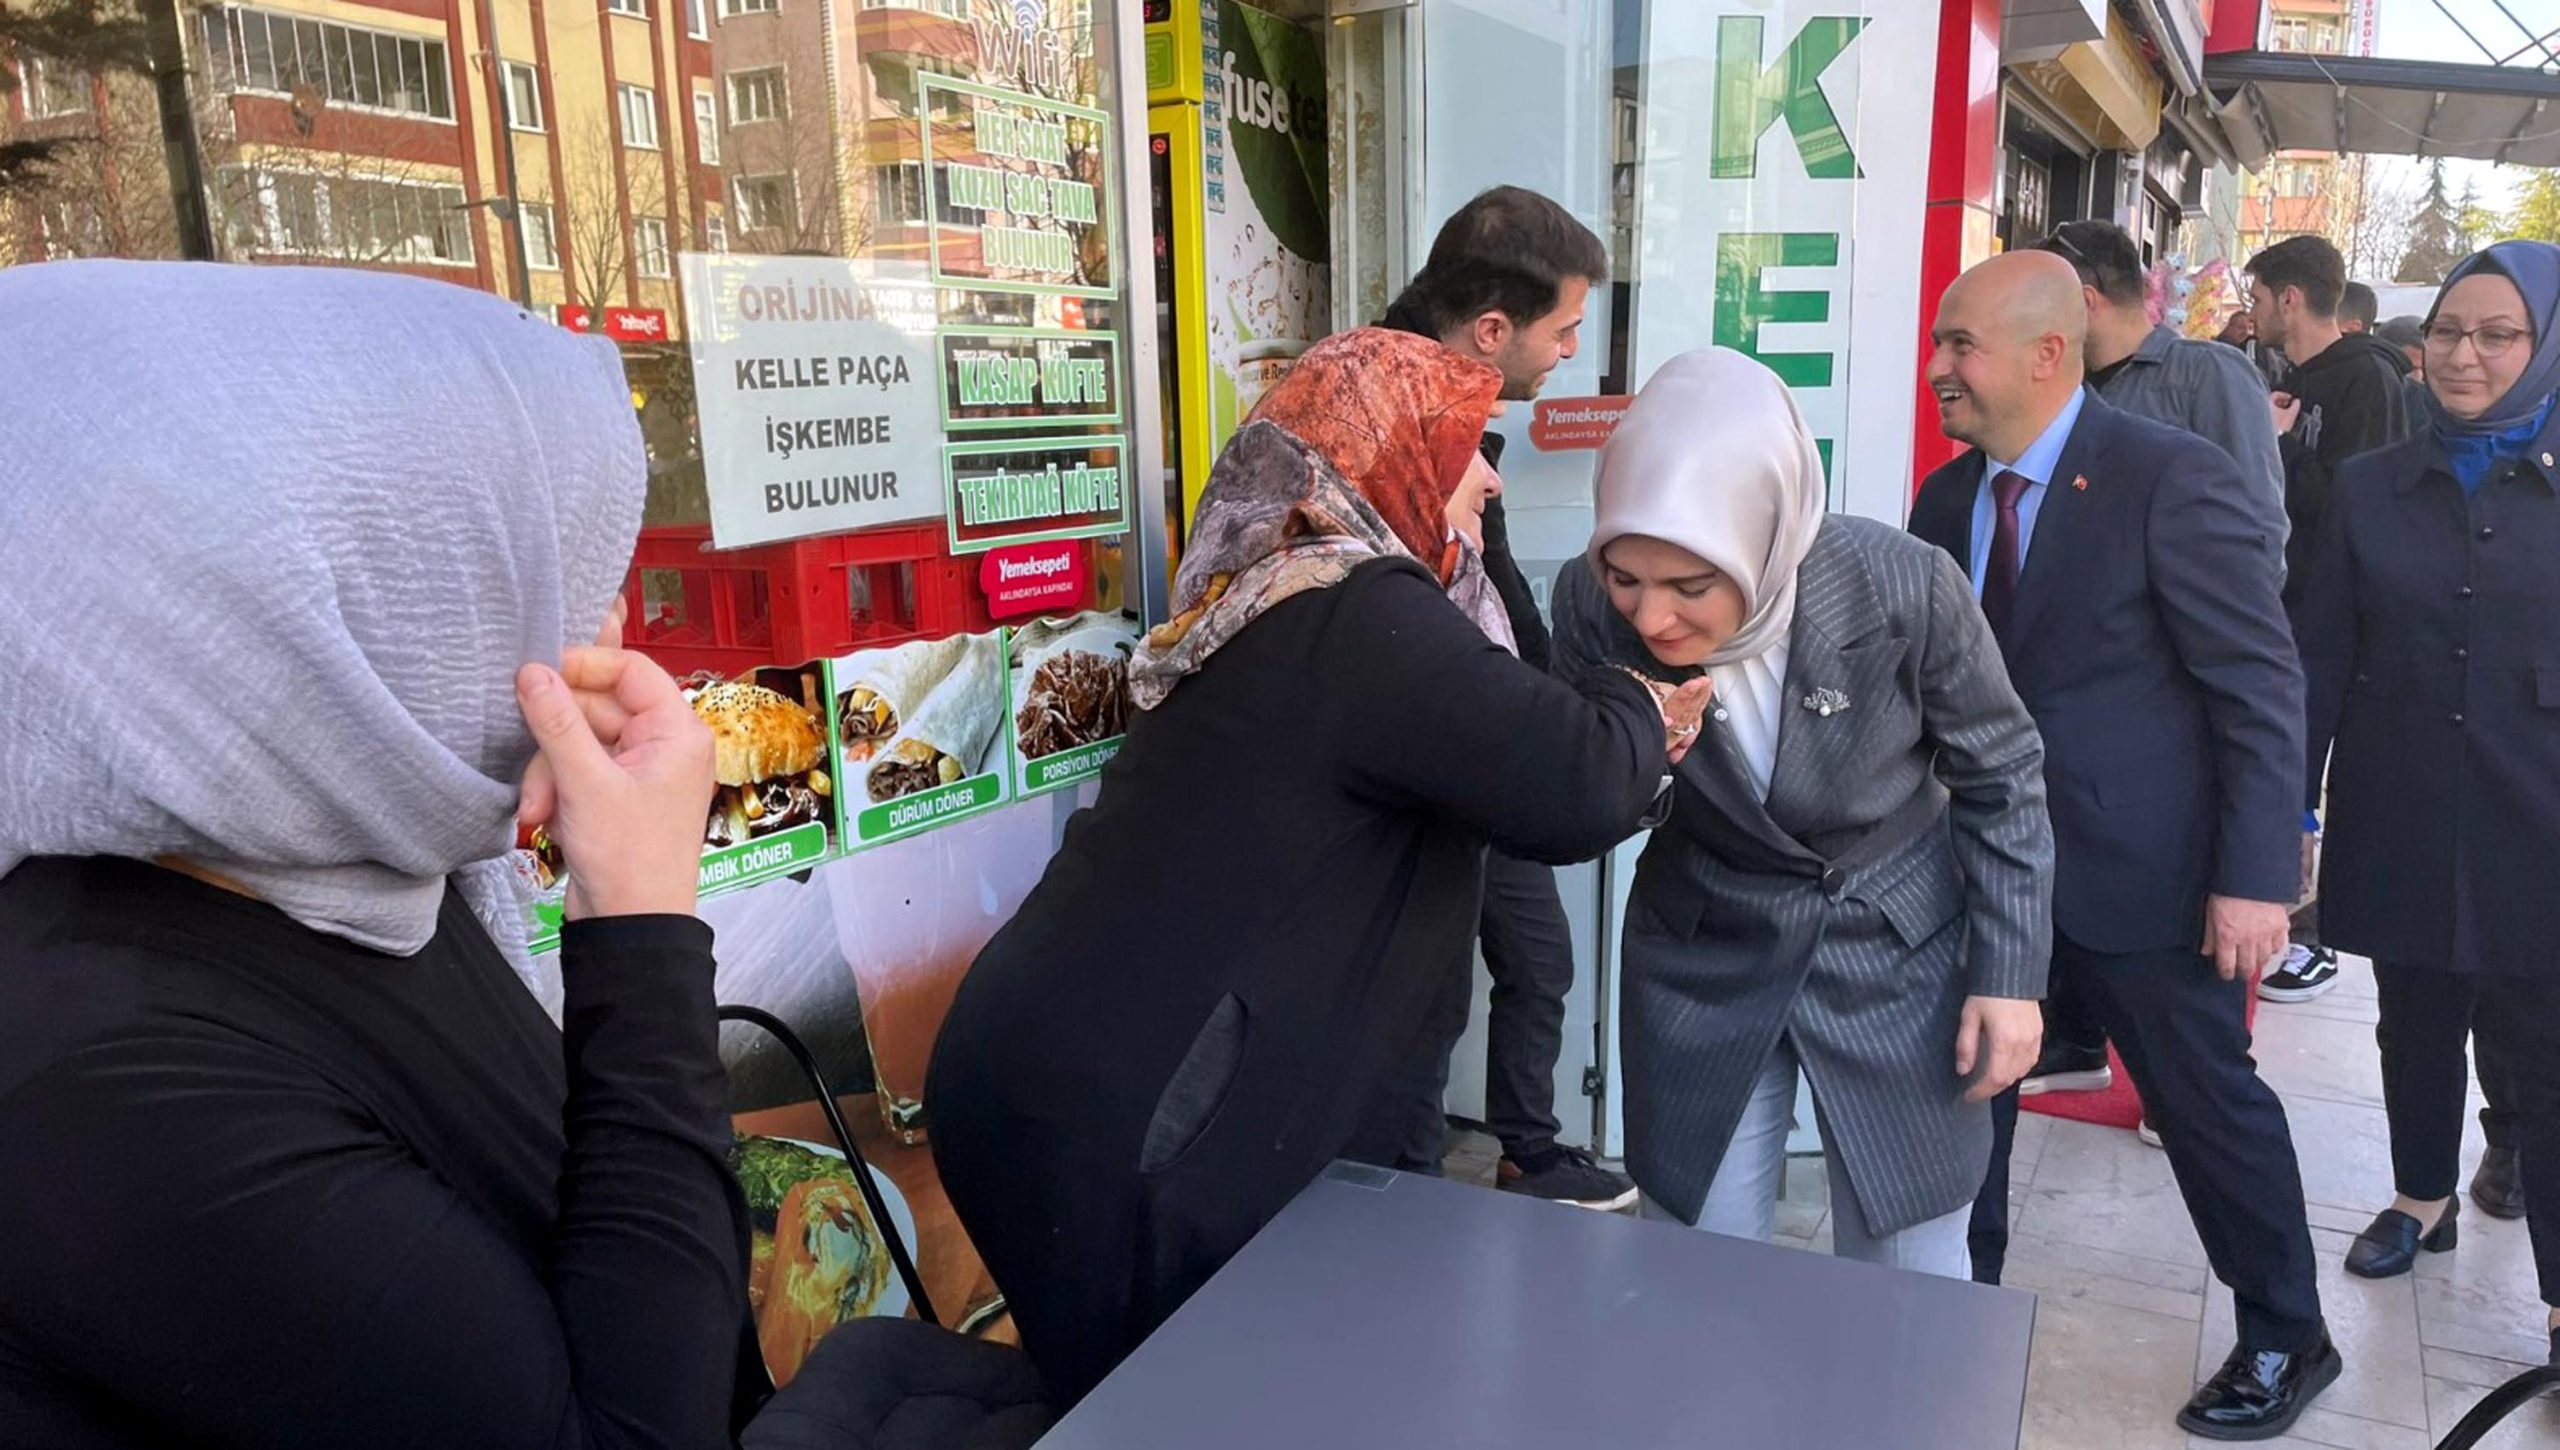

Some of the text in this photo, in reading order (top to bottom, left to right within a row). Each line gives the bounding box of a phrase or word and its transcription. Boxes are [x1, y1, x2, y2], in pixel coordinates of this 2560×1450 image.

[970, 16, 1063, 90] Wifi
[974, 110, 1067, 167] HER SAAT
[948, 162, 1005, 212] KUZU
[1048, 178, 1097, 225] TAVA
[982, 223, 1075, 275] BULUNUR
[738, 277, 878, 322] ORİJİNA
[735, 354, 910, 391] KELLE PAÇA
[958, 351, 1107, 406] KASAP KÖFTE
[766, 415, 891, 460] İŞKEMBE
[765, 471, 899, 514] BULUNUR
[958, 461, 1120, 526] TEKİRDAĞ KÖFTE
[998, 551, 1071, 583] Yemeksepeti
[1042, 756, 1091, 783] PORSİYON
[888, 787, 975, 829] DÜRÜM DÖNER
[699, 840, 793, 887] MBİK DÖNER
